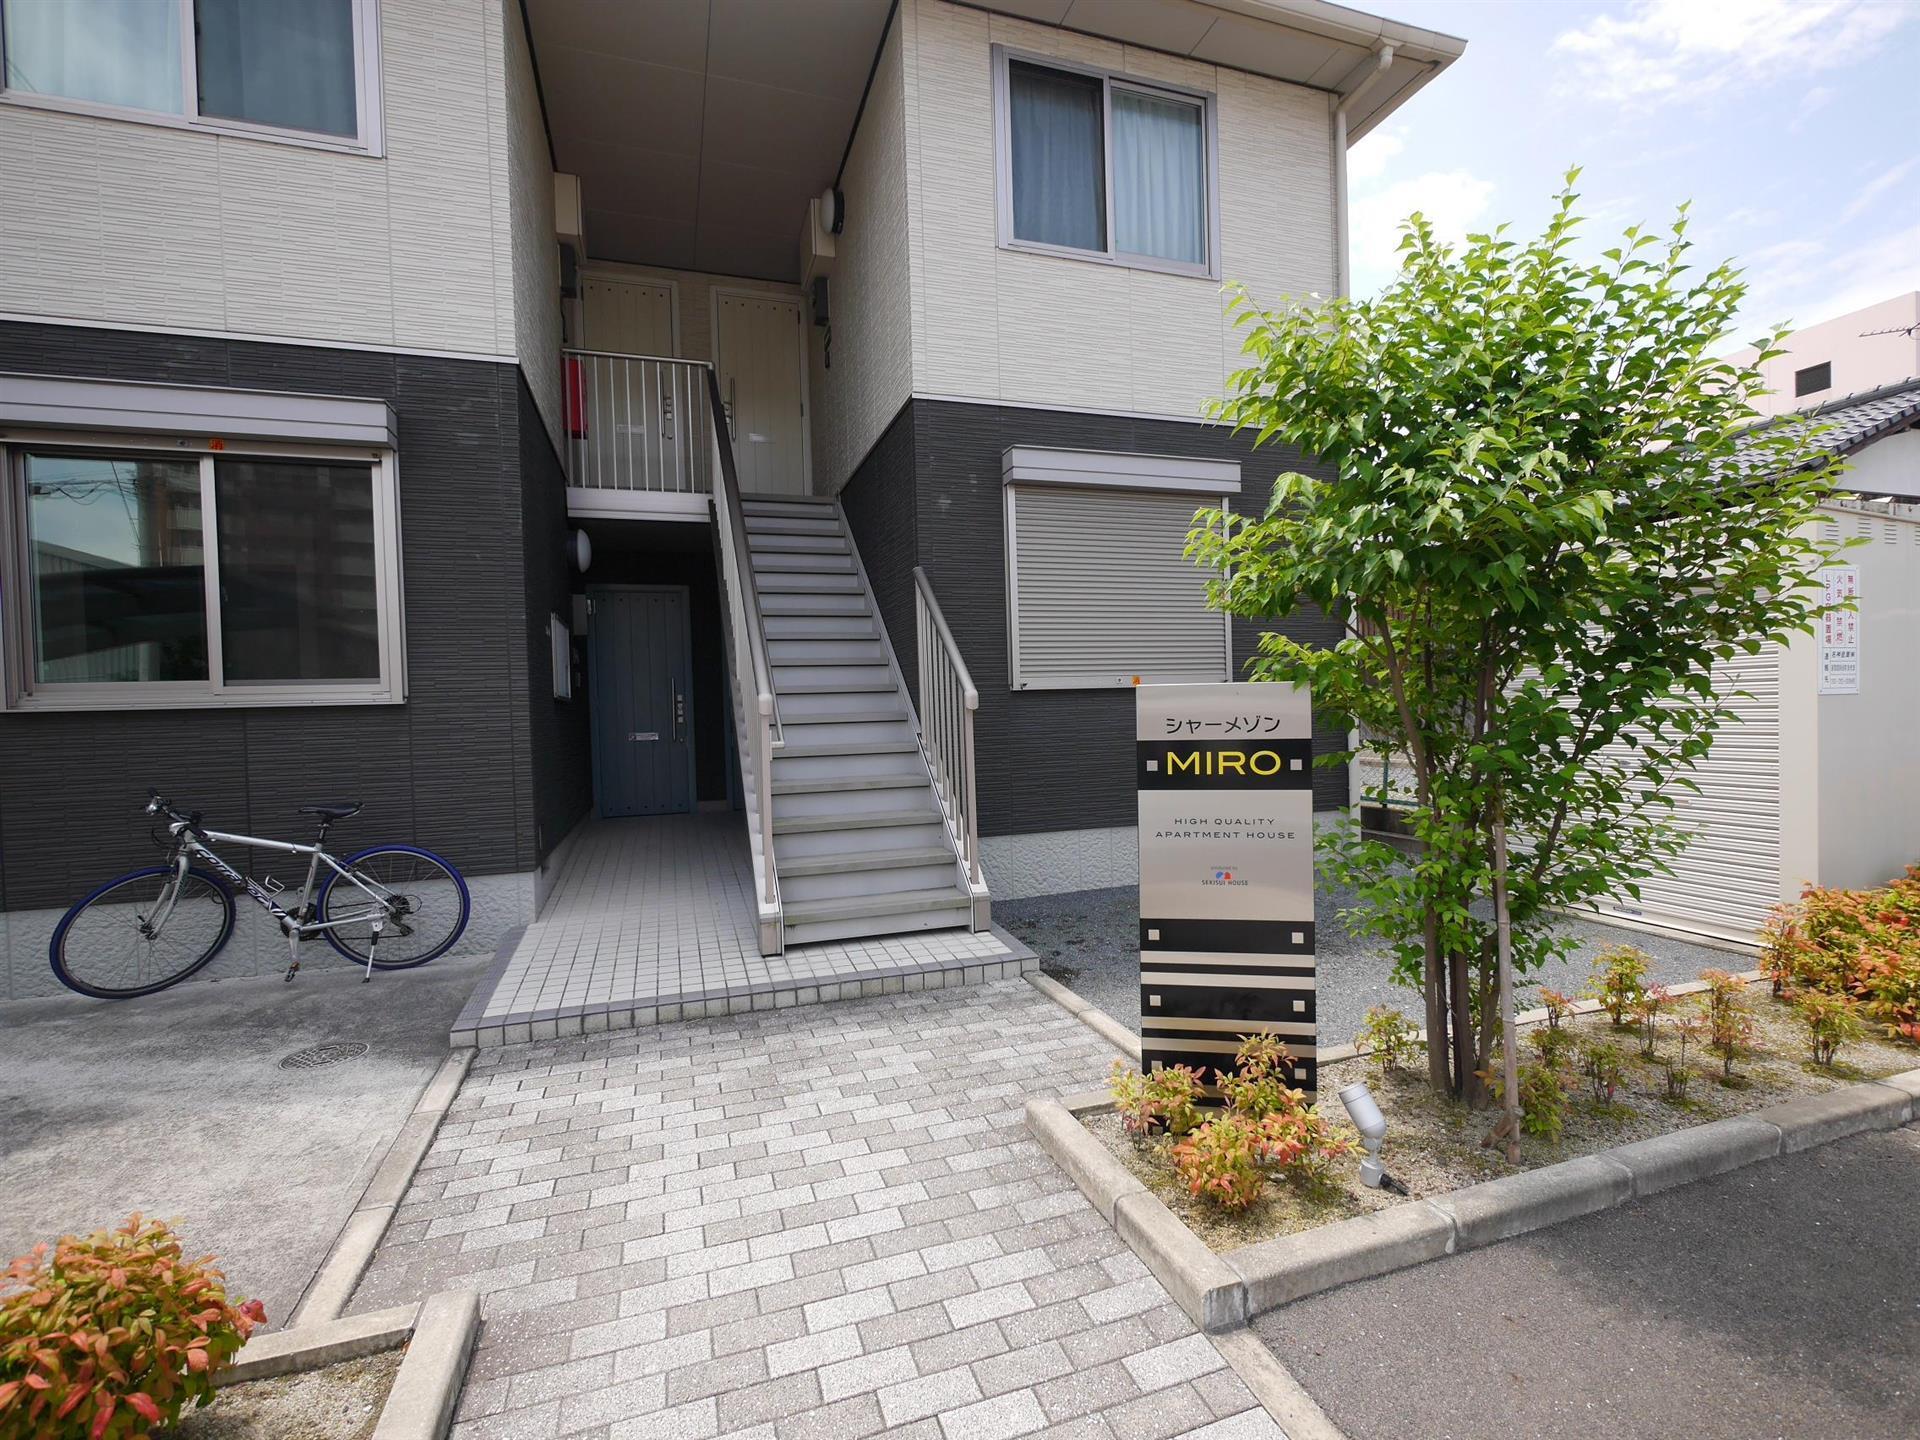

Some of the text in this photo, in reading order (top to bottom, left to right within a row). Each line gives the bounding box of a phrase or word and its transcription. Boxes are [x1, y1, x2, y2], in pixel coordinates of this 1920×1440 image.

[1165, 715, 1281, 735] シャーメゾン
[1167, 750, 1282, 776] MIRO
[1174, 818, 1276, 826] HIGH QUALITY
[1155, 831, 1296, 840] APARTMENT HOUSE
